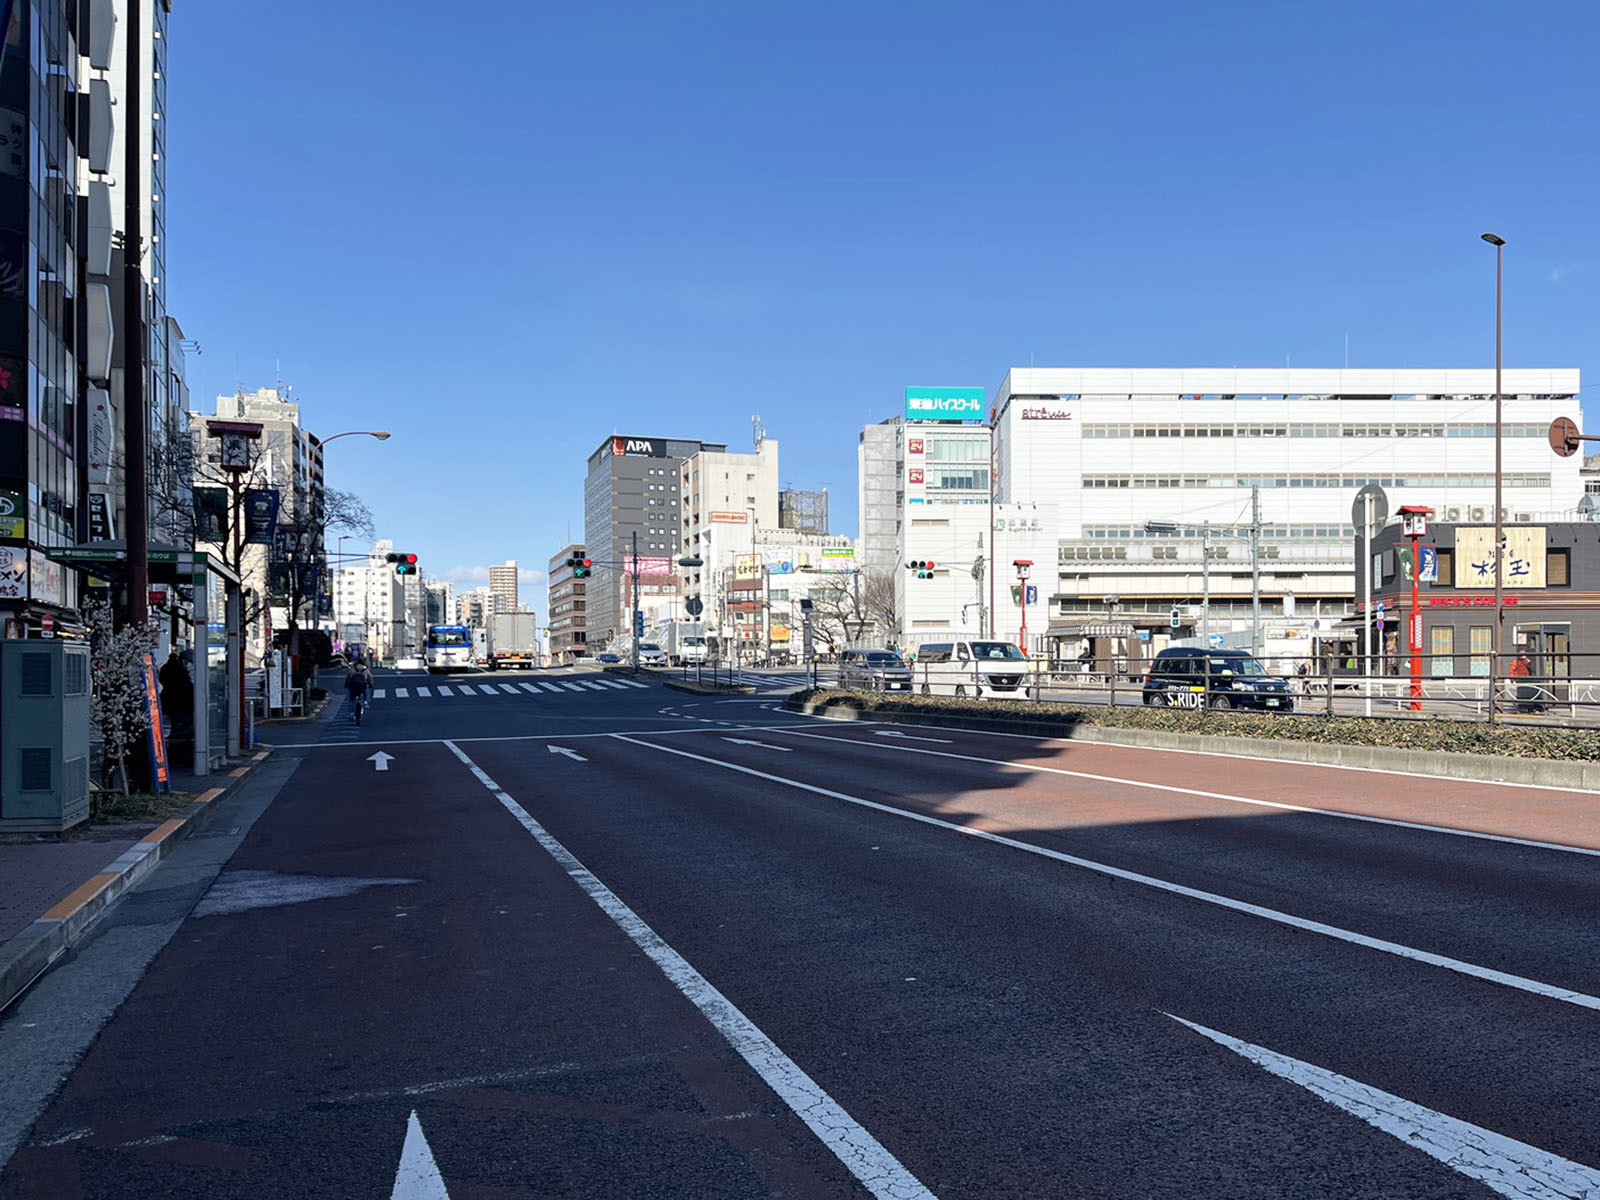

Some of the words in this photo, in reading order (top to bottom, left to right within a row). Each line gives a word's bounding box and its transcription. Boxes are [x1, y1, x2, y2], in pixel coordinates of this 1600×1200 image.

[909, 398, 980, 411] 東進ハイスクール
[626, 440, 652, 452] APA
[1167, 692, 1205, 708] S.RIDE
